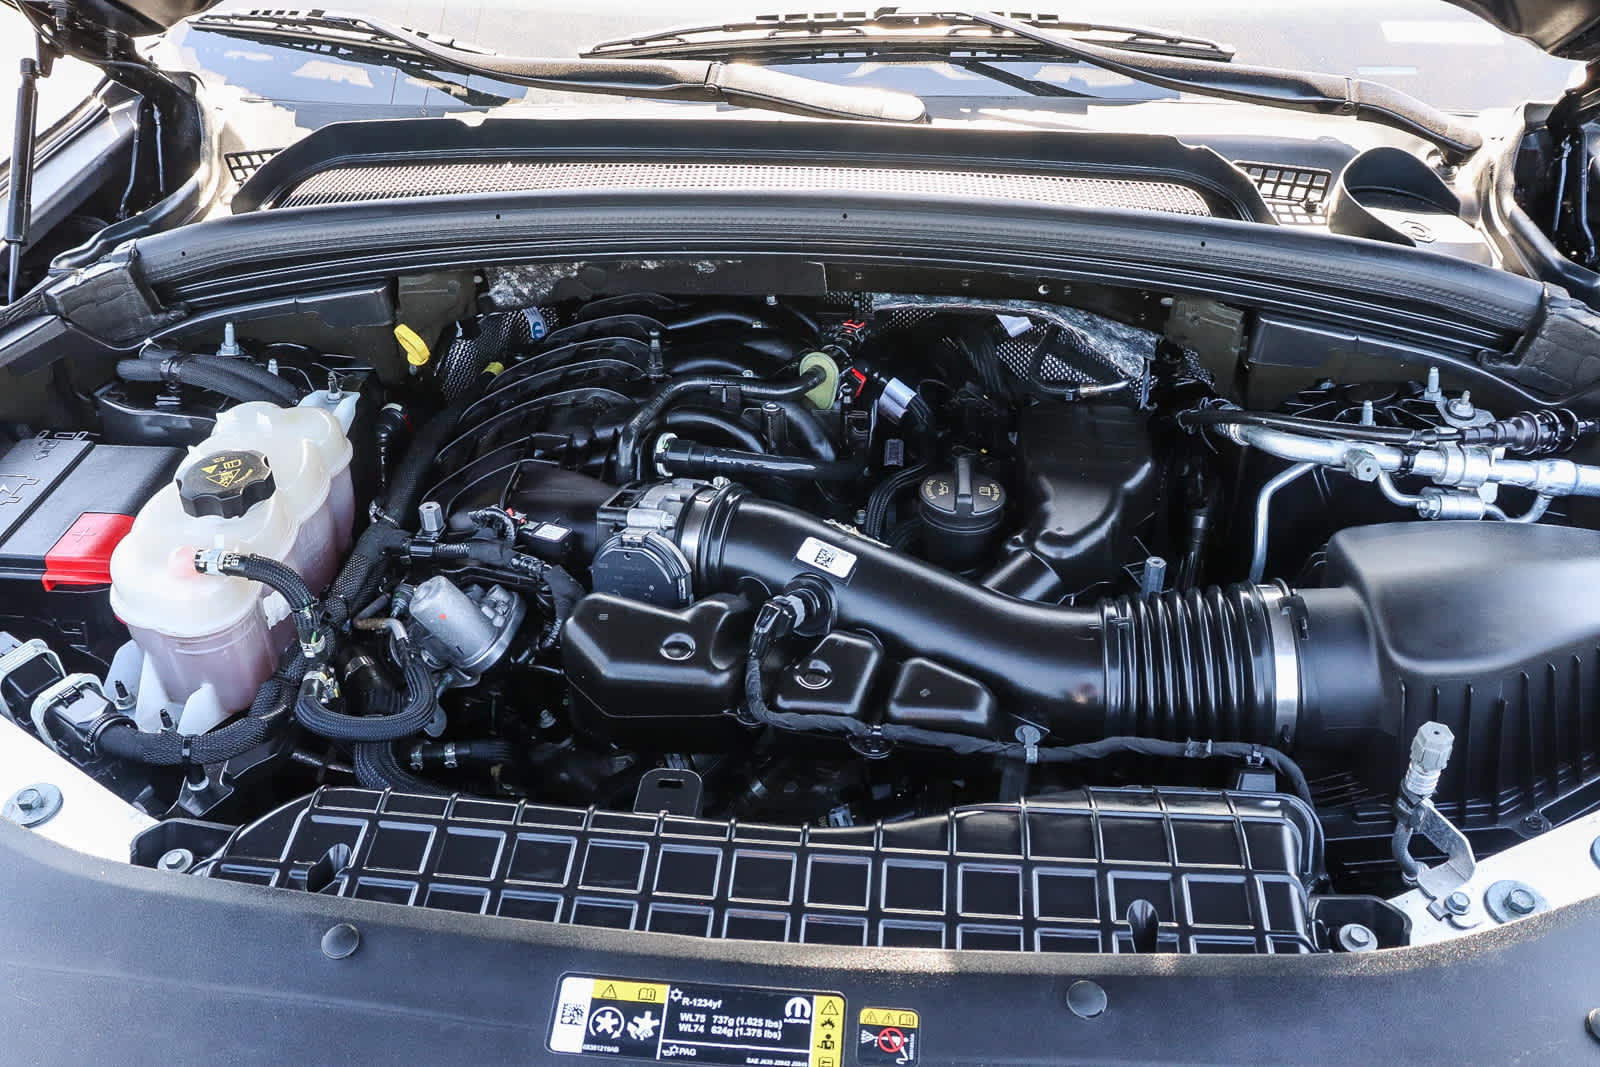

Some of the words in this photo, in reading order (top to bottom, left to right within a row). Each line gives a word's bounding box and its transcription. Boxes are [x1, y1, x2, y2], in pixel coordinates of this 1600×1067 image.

[681, 997, 722, 1009] R-1234yf
[680, 1012, 706, 1023] WL75
[712, 1015, 735, 1026] 737g
[765, 1019, 783, 1030] lbs)
[678, 1023, 704, 1034] WL74
[735, 1027, 763, 1039] (1.375
[764, 1030, 782, 1040] lbs)
[679, 1047, 696, 1057] PAG
